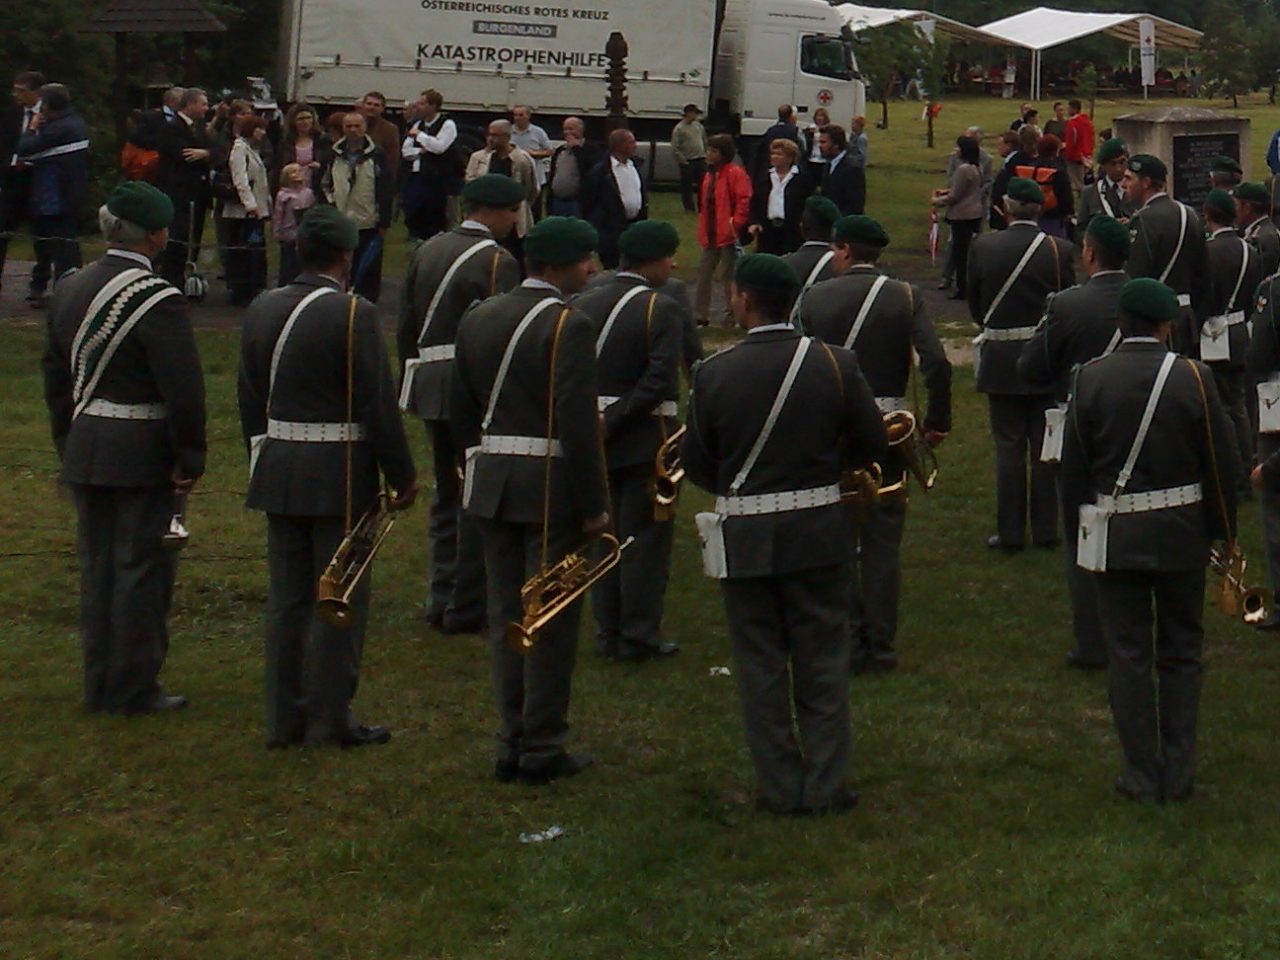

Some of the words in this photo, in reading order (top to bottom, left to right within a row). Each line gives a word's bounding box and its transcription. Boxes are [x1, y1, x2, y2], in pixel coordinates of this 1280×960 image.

[534, 6, 569, 18] ROTES
[572, 9, 609, 21] KREUZ
[478, 23, 552, 37] BURGENLAND
[417, 44, 606, 67] KATASTROPHENHILFE
